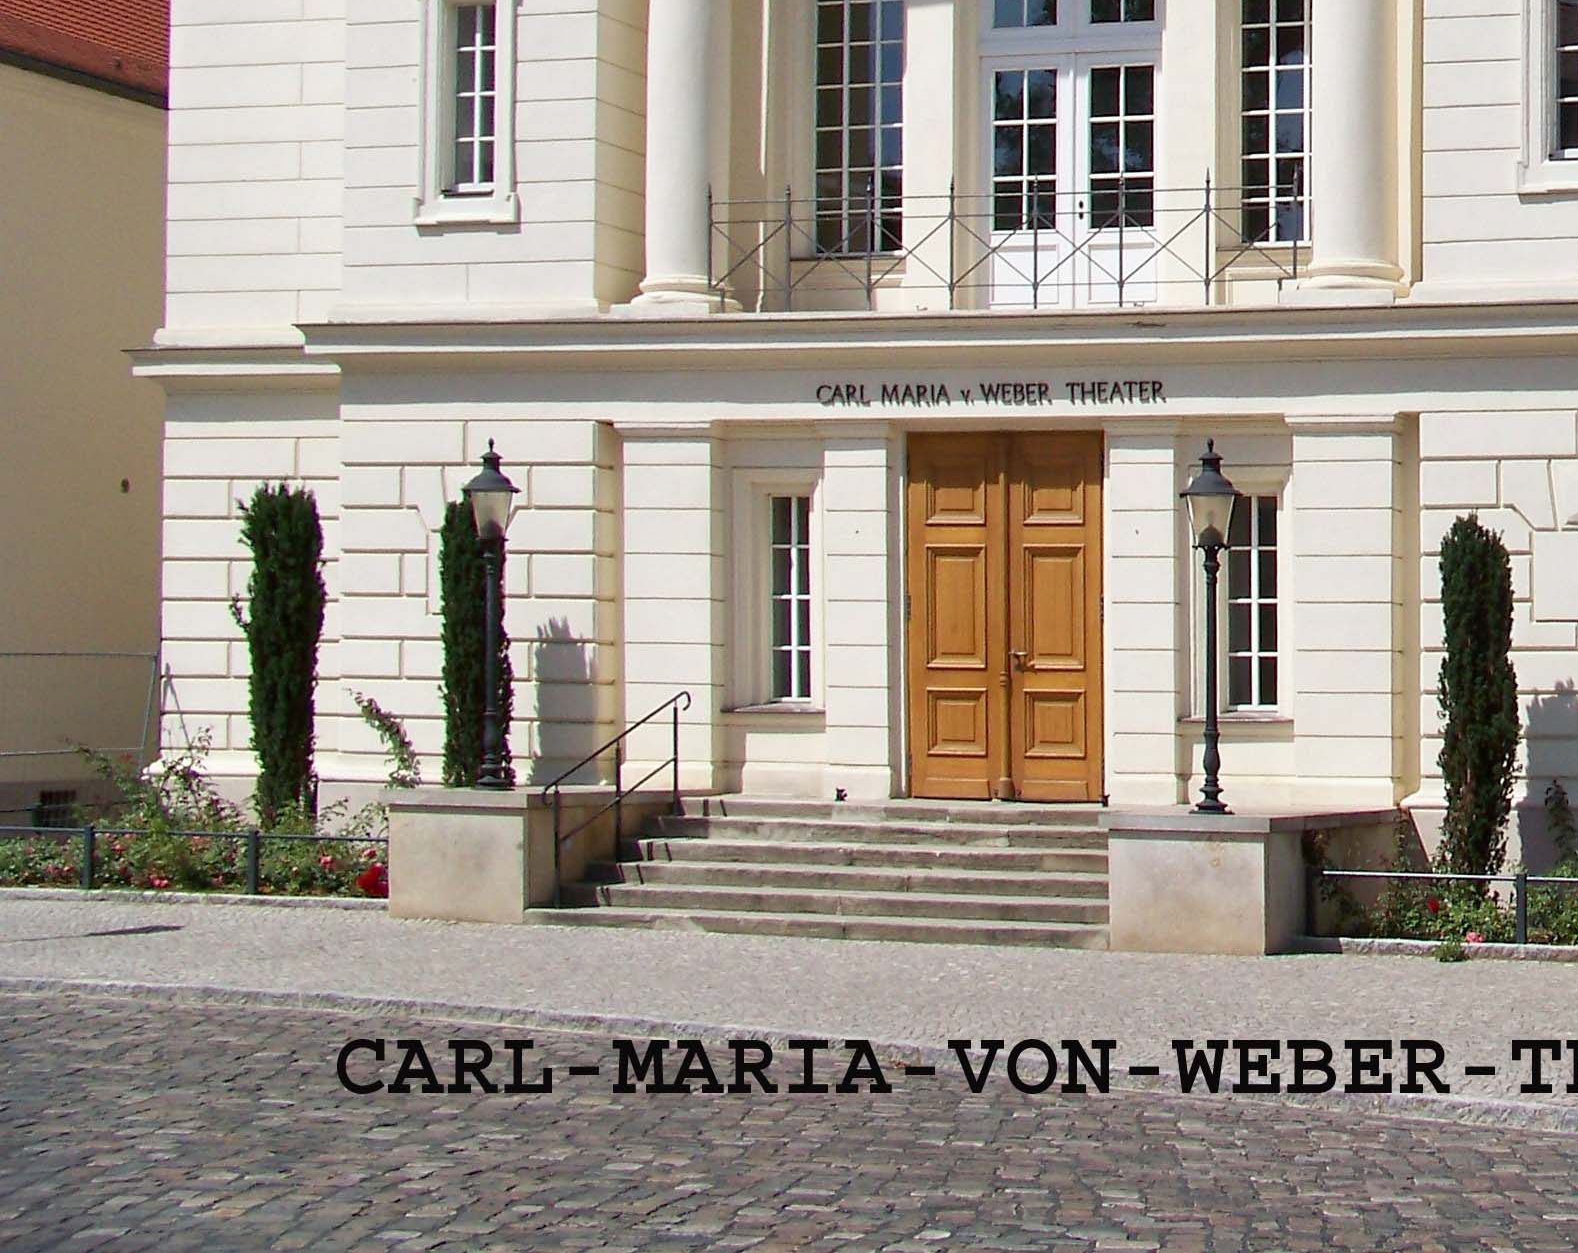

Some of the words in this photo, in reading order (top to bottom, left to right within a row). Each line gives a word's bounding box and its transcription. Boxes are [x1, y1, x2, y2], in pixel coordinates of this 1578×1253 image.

[816, 384, 871, 406] CARL
[881, 383, 951, 407] MARIA
[979, 382, 1053, 406] WEBER
[1065, 381, 1167, 405] THEATER
